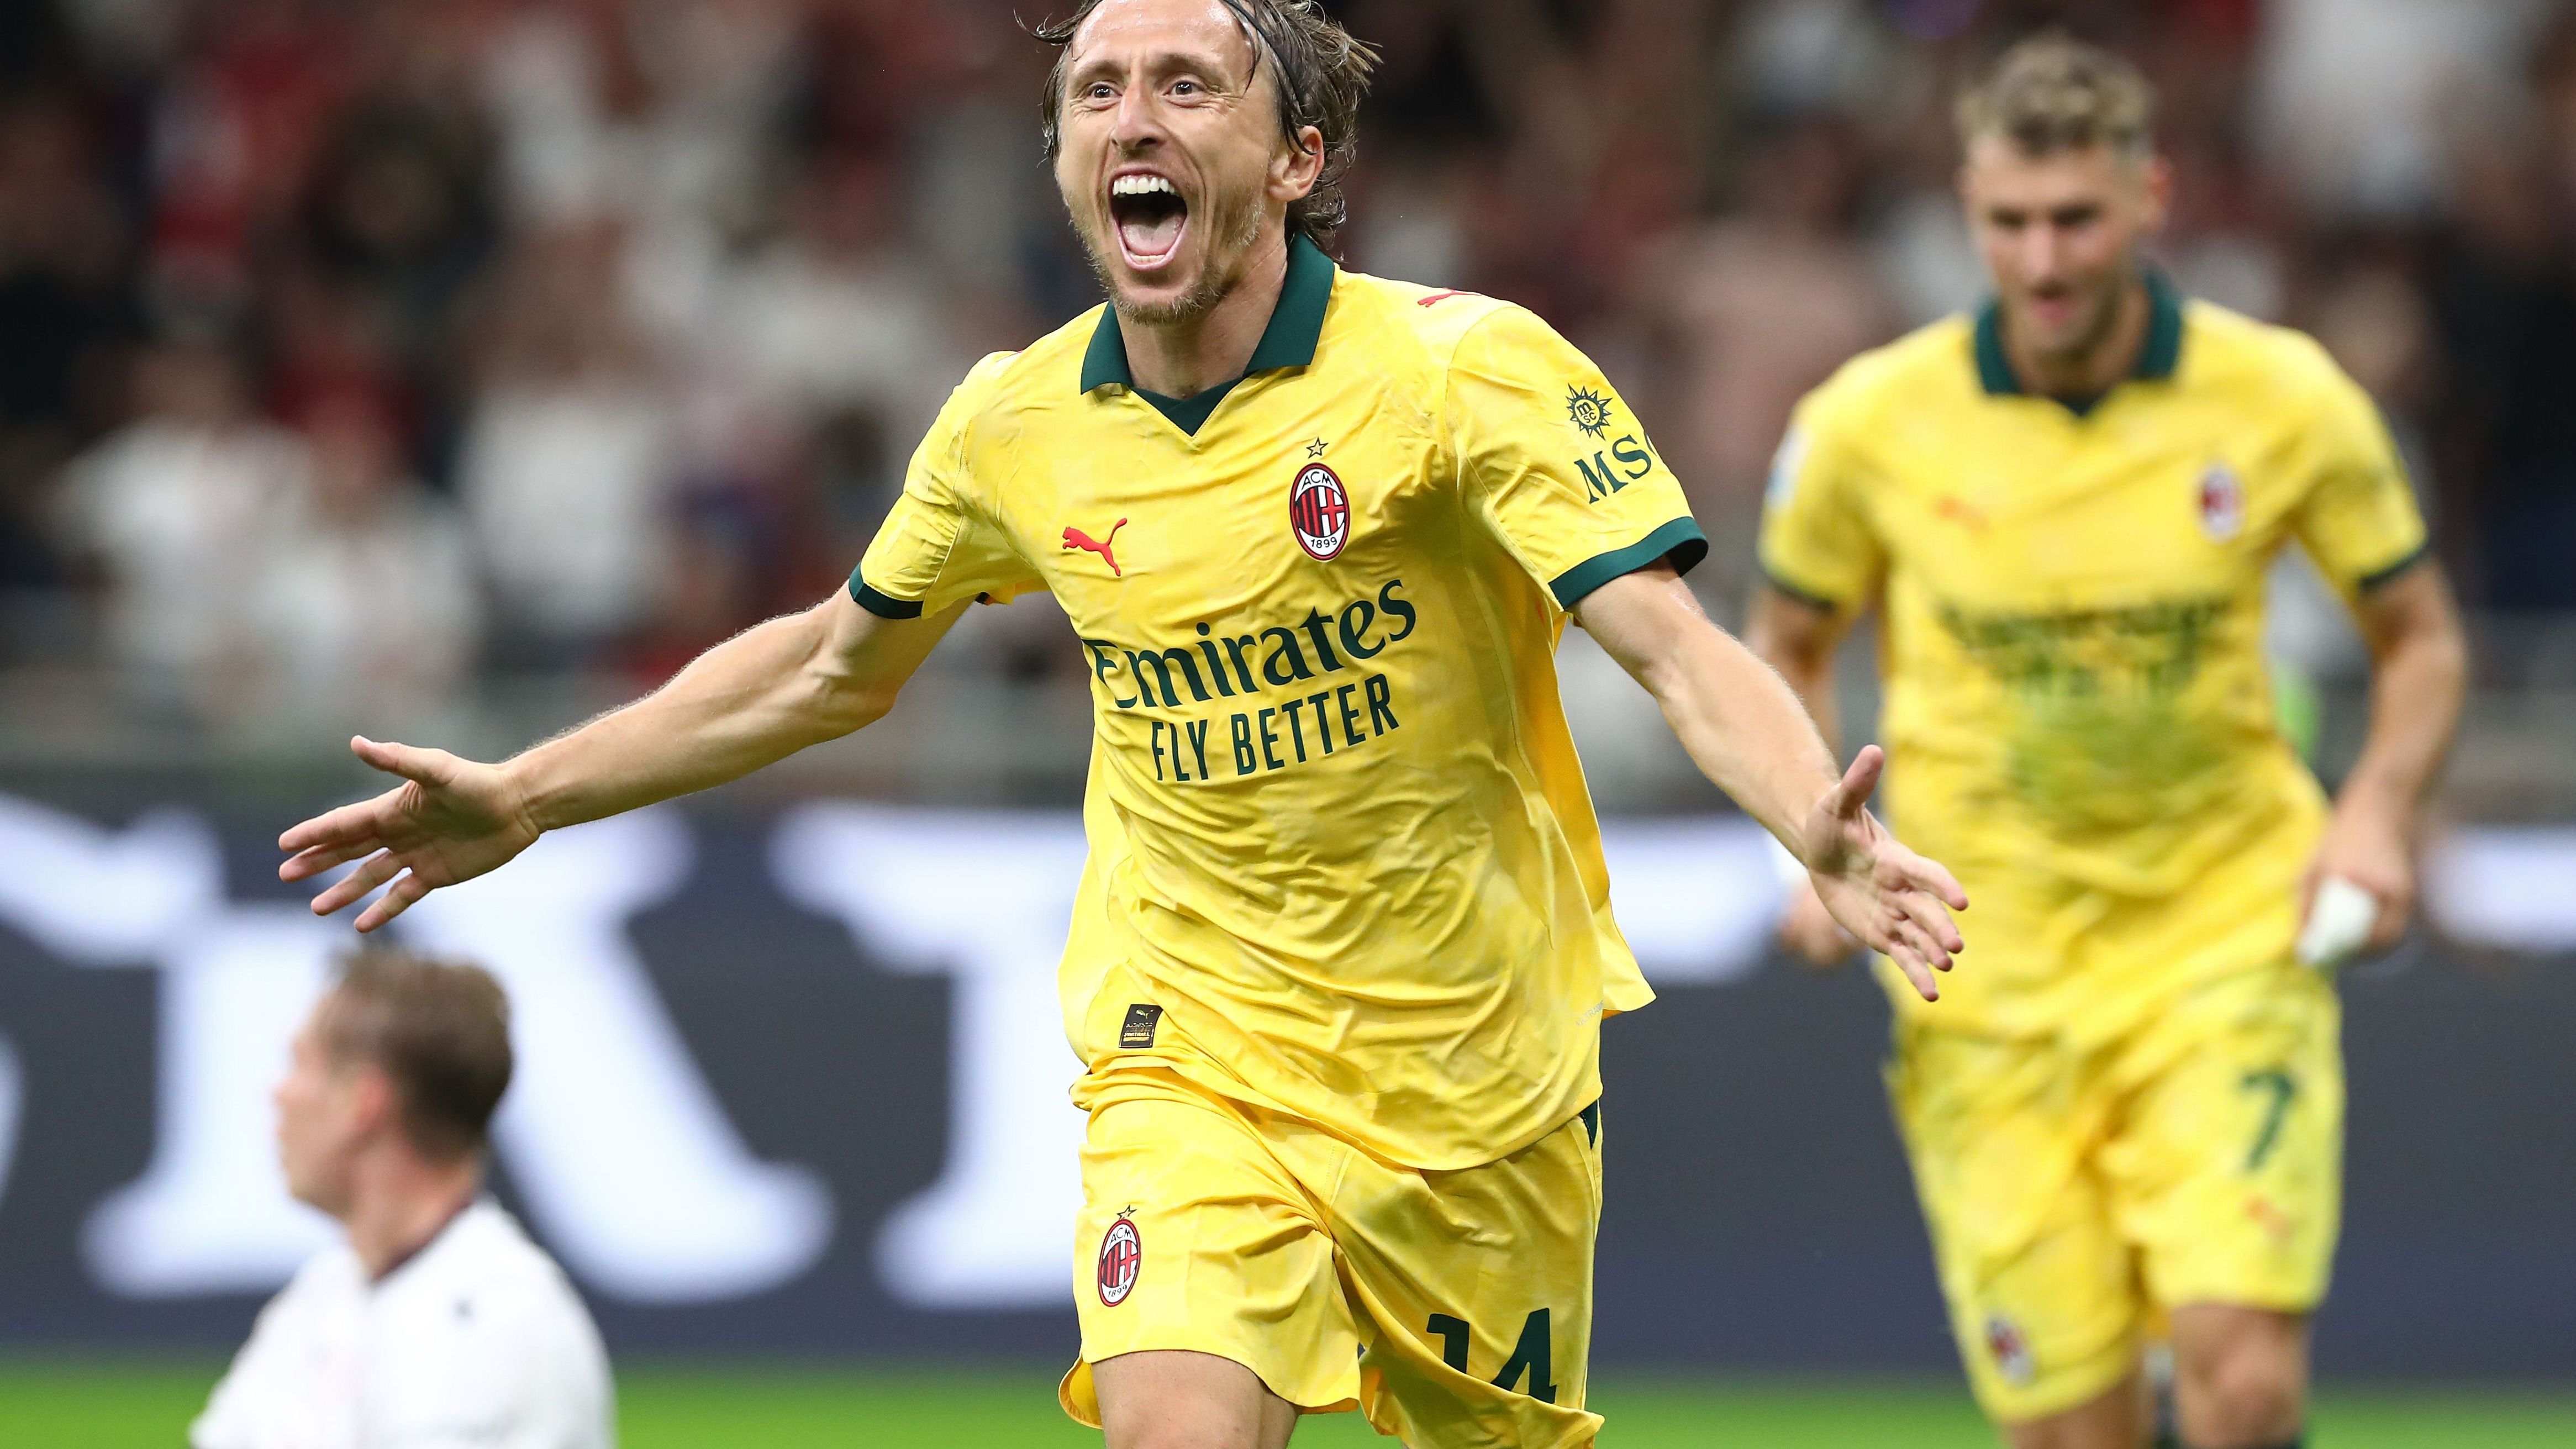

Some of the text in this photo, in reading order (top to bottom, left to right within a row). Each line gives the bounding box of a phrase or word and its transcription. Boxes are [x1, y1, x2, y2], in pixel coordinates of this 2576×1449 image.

[1302, 471, 1333, 491] ACM
[1574, 434, 1657, 504] MS
[1310, 536, 1337, 549] 1899
[1082, 579, 1416, 709] Emirates
[1151, 673, 1400, 782] FLY BETTER
[2239, 1068, 2295, 1172] 7
[1109, 1227, 1131, 1248] ACM
[1108, 1284, 1128, 1298] 1899
[1426, 1307, 1557, 1404] 14
